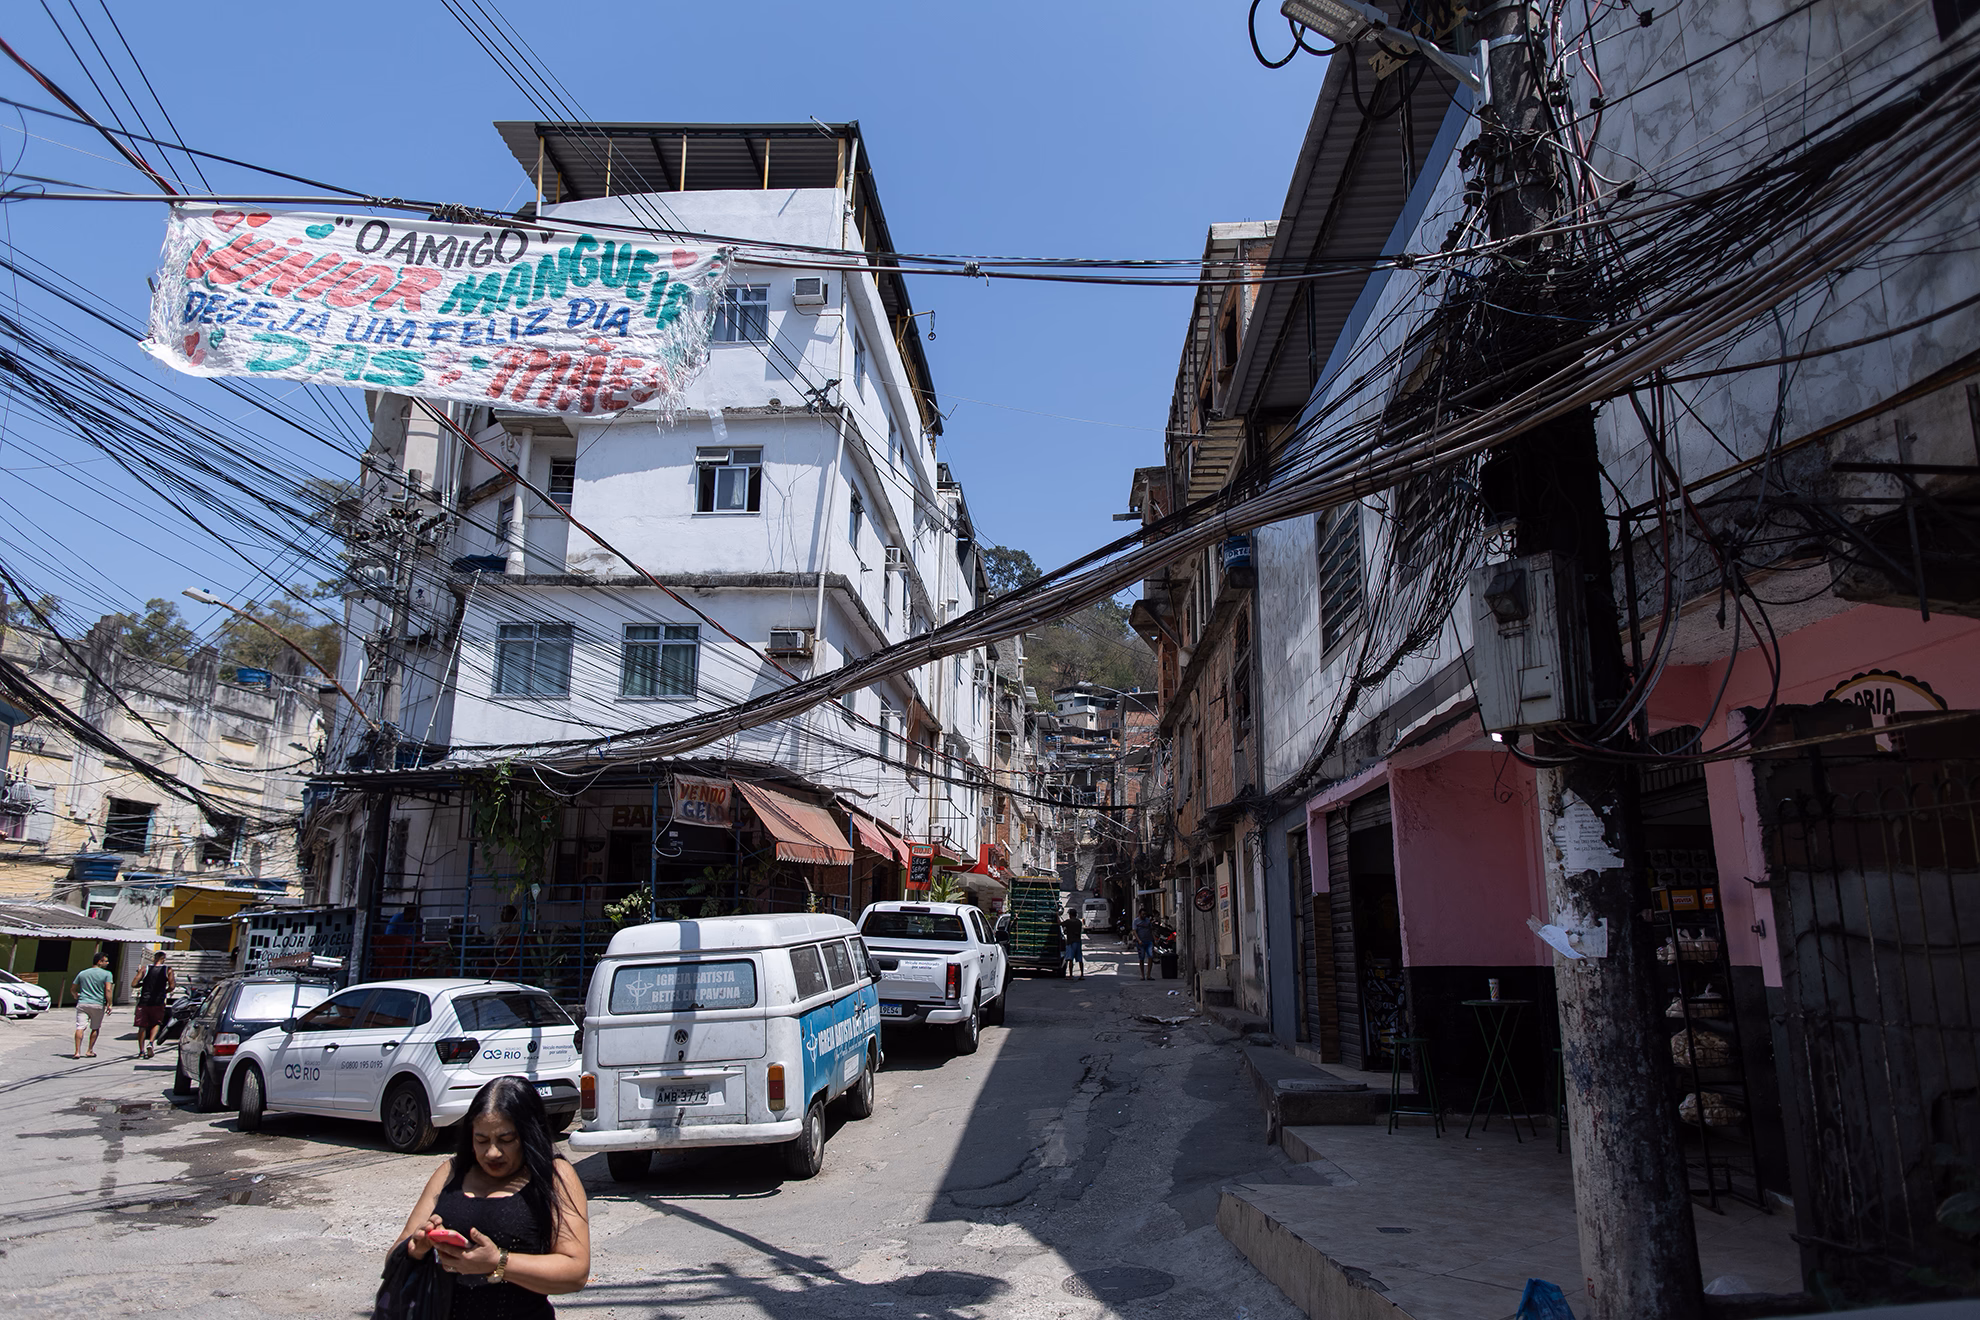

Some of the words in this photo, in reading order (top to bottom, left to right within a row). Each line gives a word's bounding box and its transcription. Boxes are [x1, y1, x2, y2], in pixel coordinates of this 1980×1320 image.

[184, 290, 332, 338] DESEJA
[345, 314, 418, 348] UM
[427, 307, 554, 347] FELIZ
[566, 297, 632, 337] DIA
[245, 332, 427, 388] DAS
[1844, 687, 1896, 716] ARIA
[680, 783, 726, 804] VENDO
[683, 800, 725, 822] GELO
[272, 935, 306, 949] LOJA
[308, 934, 329, 948] DVD
[656, 972, 691, 987] IGREJA
[693, 970, 735, 985] BATISTA
[651, 989, 681, 1003] BETEL
[682, 988, 697, 1001] EM
[503, 1050, 522, 1060] RIO
[345, 1060, 358, 1070] 0800
[359, 1060, 370, 1069] 195
[369, 1060, 384, 1069] 0195
[302, 1067, 321, 1081] RIO
